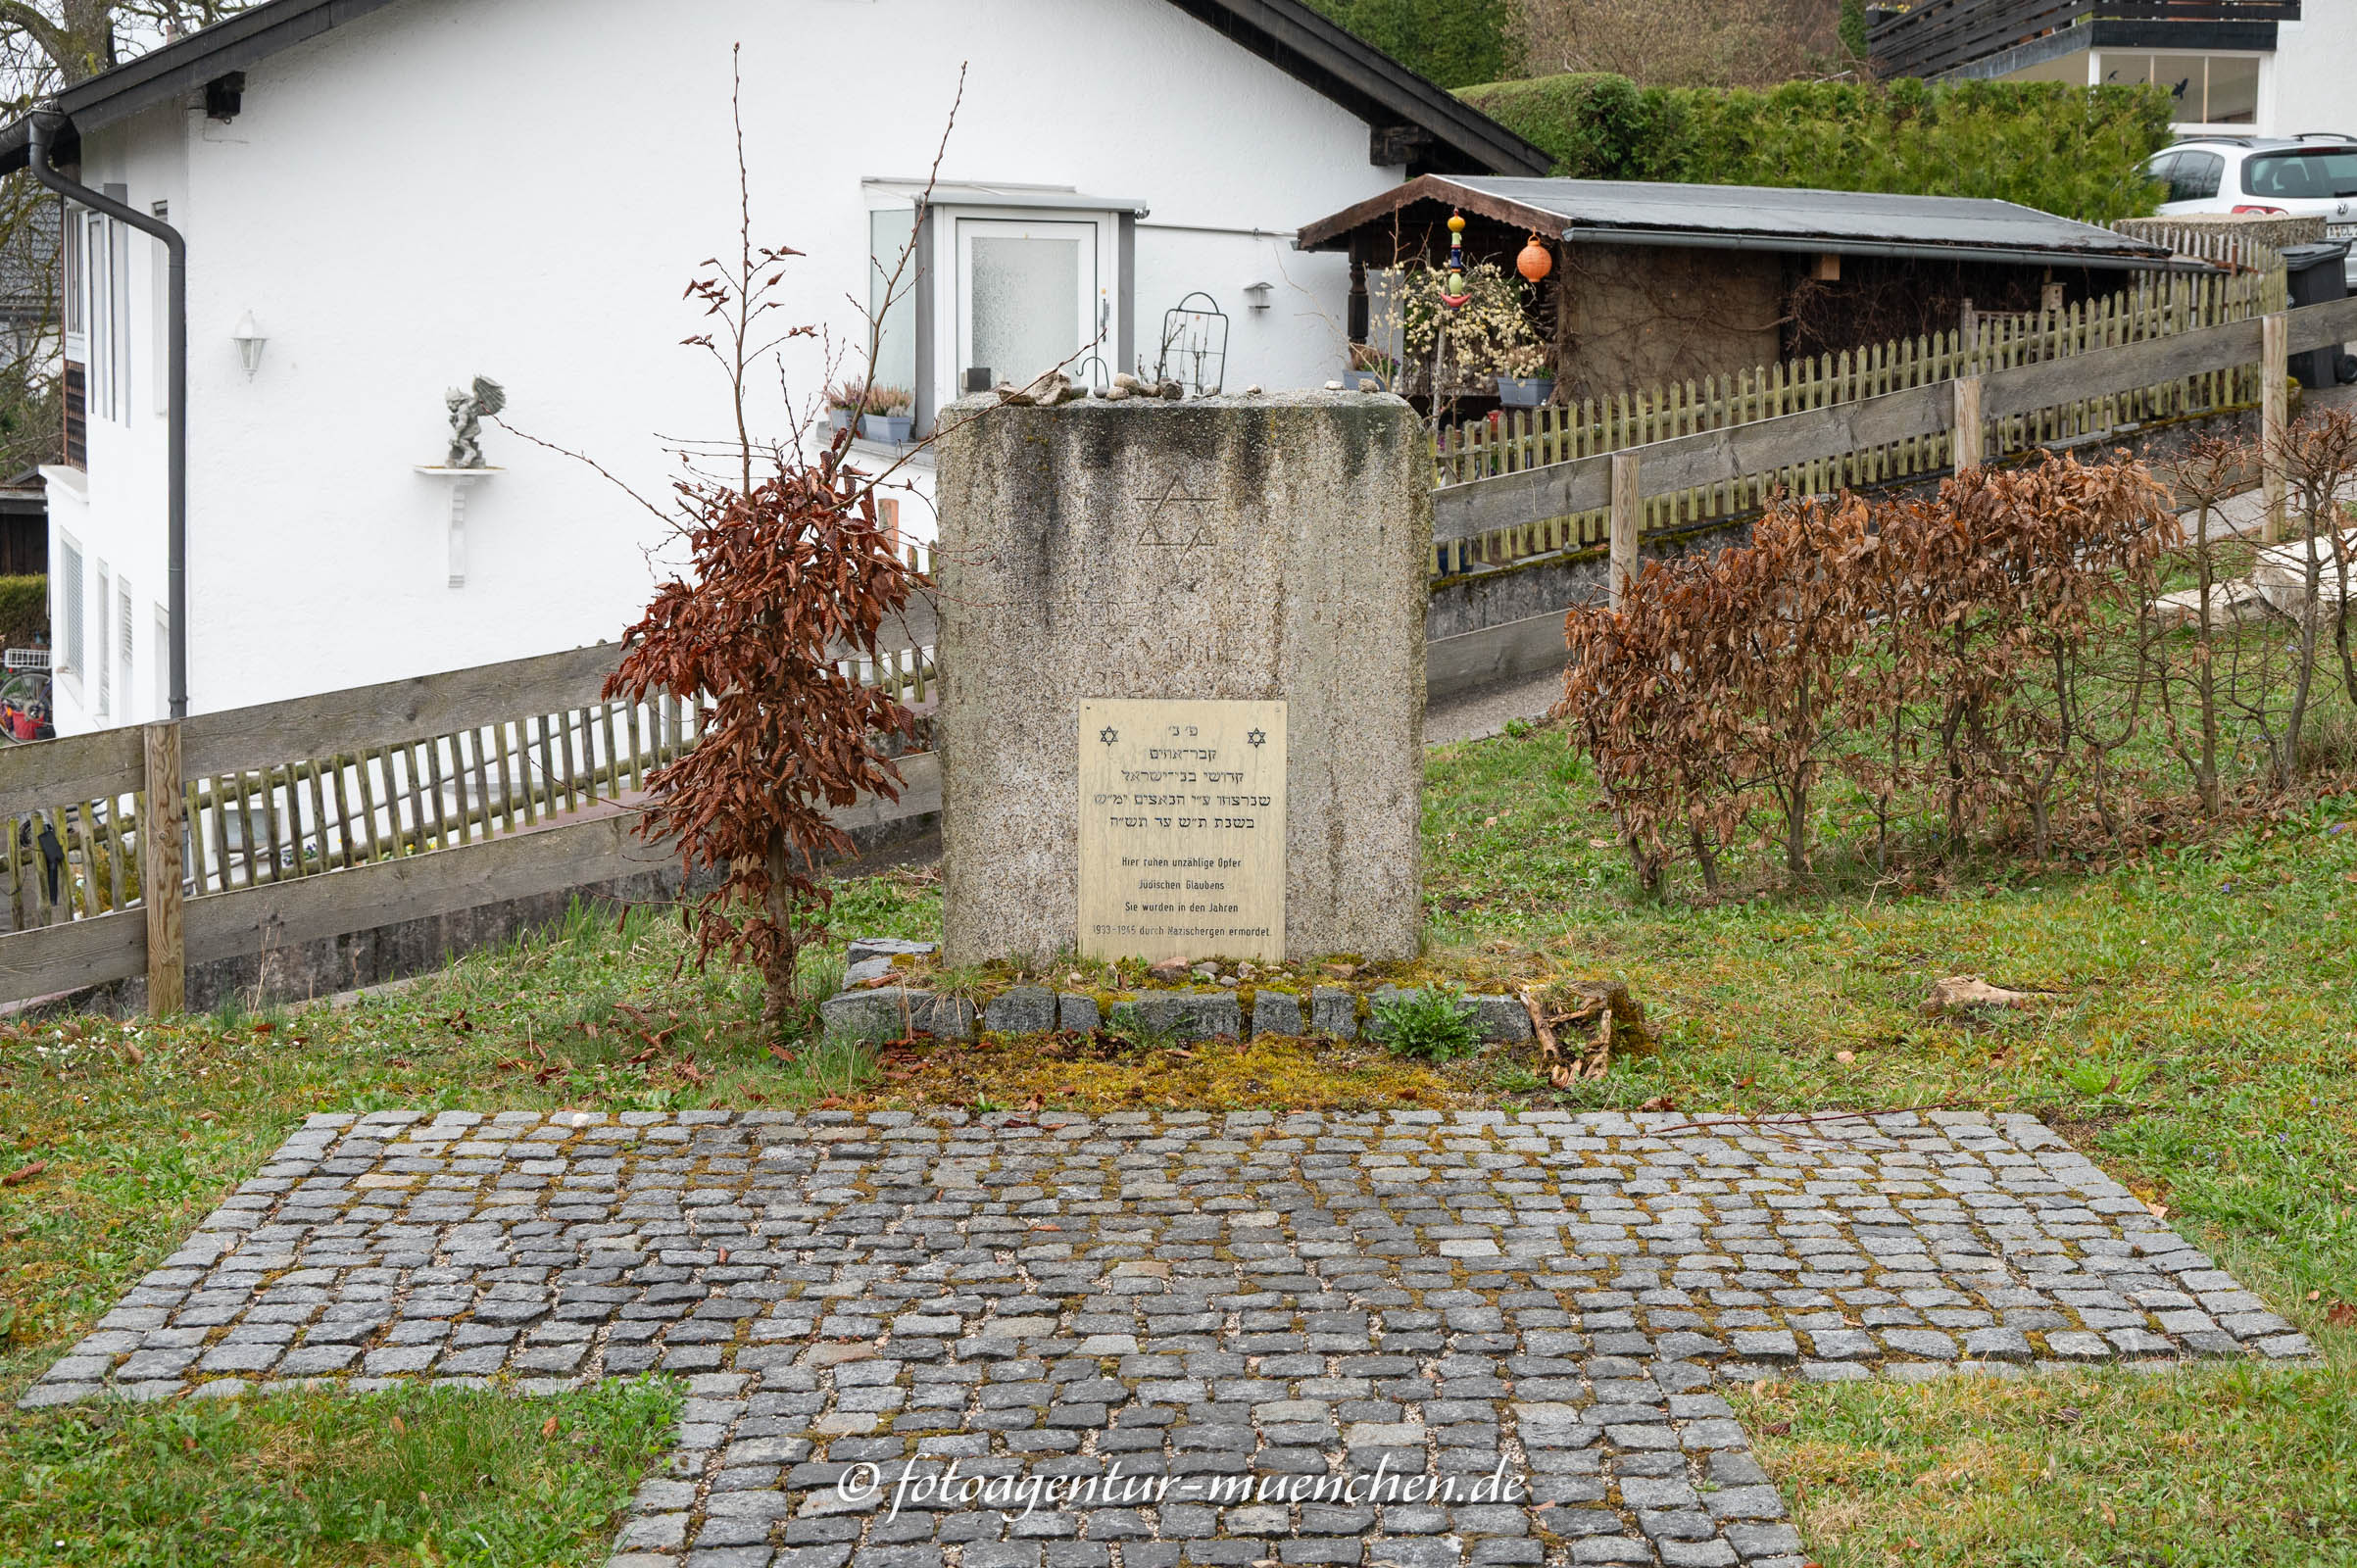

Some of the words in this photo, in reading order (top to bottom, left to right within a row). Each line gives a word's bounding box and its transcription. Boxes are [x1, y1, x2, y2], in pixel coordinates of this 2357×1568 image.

[1121, 857, 1140, 867] Hier
[1143, 857, 1169, 867] ruhen
[1171, 856, 1214, 870] unzählige
[1217, 858, 1243, 869] Opfer
[1138, 879, 1181, 890] Jüdischen
[1124, 902, 1138, 912] Sie
[1142, 902, 1175, 912] wurden
[1177, 902, 1187, 912] in
[1189, 902, 1205, 912] den
[1207, 902, 1239, 913] Jahren
[1139, 925, 1165, 936] durch
[1167, 925, 1225, 939] Nazischergen
